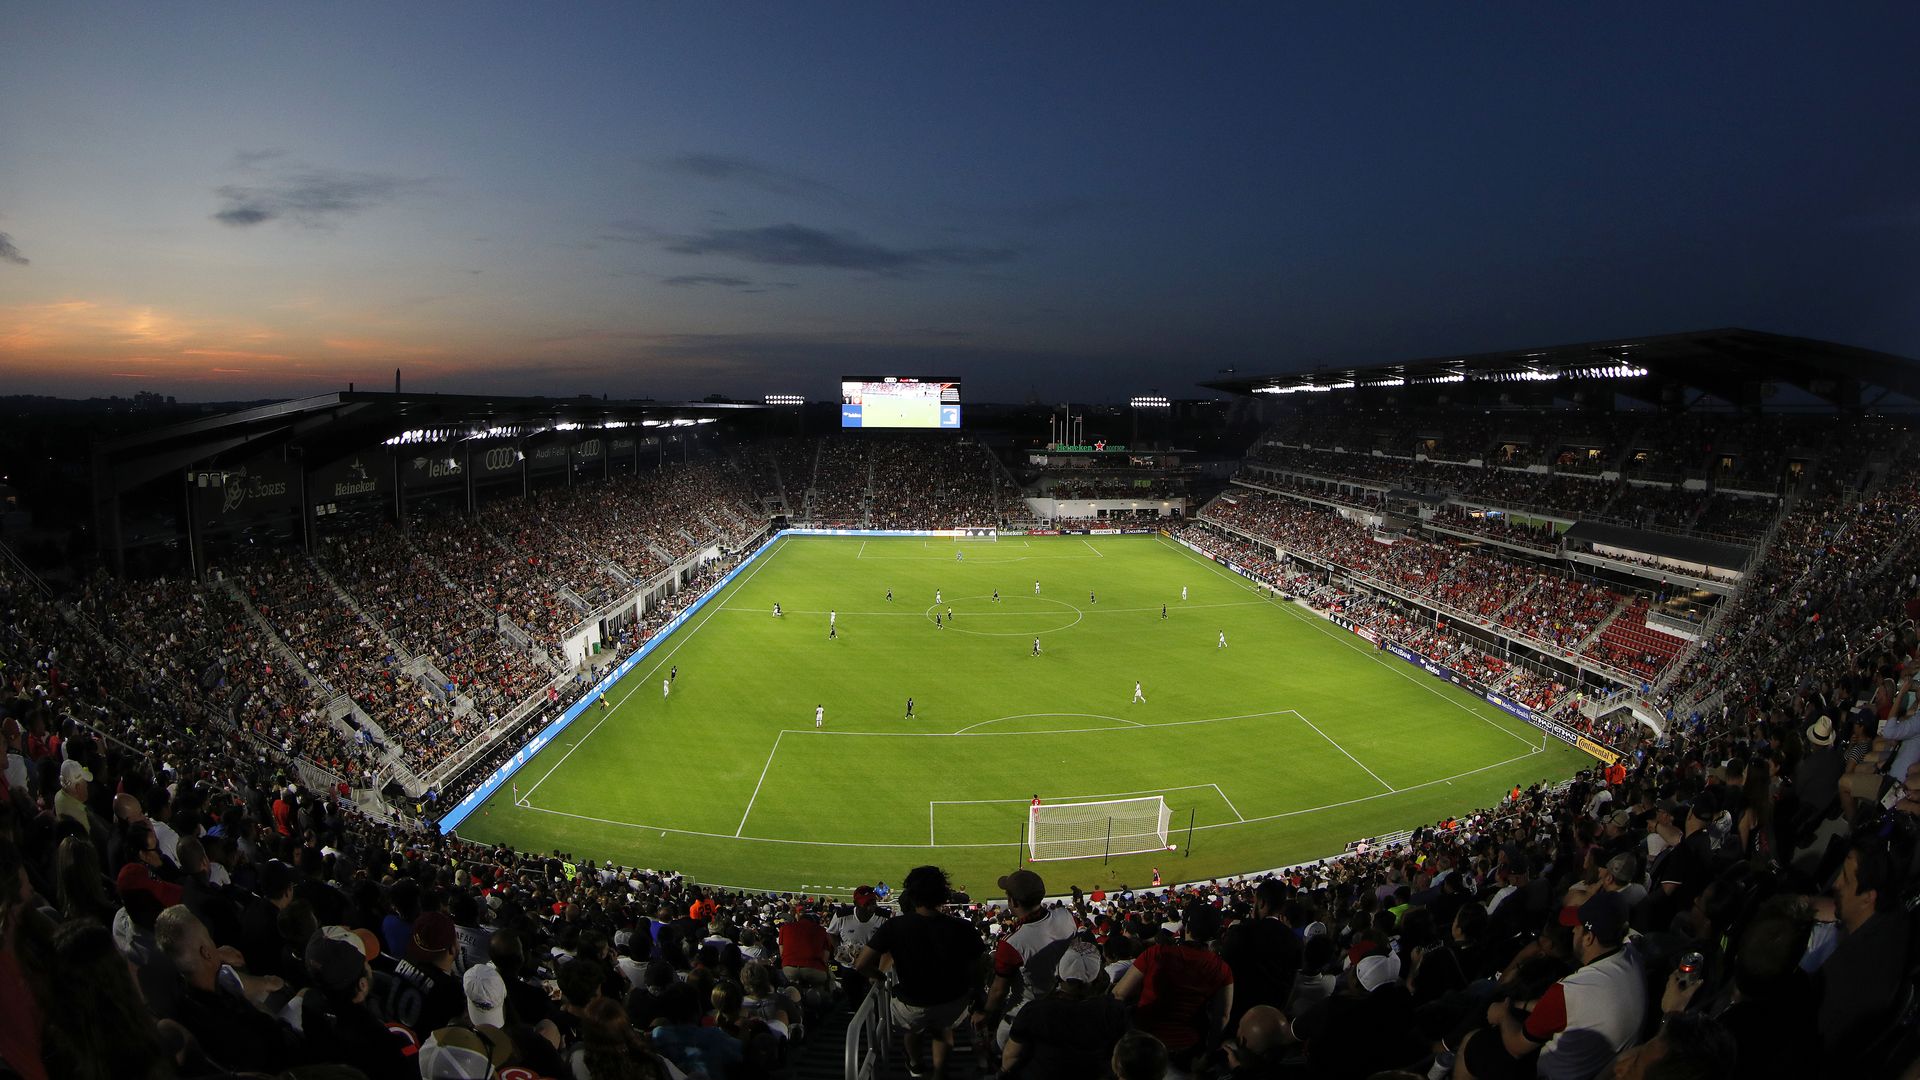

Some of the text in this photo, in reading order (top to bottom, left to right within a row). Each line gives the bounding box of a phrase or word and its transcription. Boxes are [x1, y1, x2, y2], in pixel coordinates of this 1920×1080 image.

[536, 449, 551, 459] Audi
[1057, 443, 1093, 452] Heineken
[335, 480, 376, 497] Heineken
[1388, 644, 1412, 661] EAGLEBANK
[1425, 663, 1440, 676] leidos
[1579, 738, 1610, 760] Continental
[456, 931, 478, 946] AFAEL
